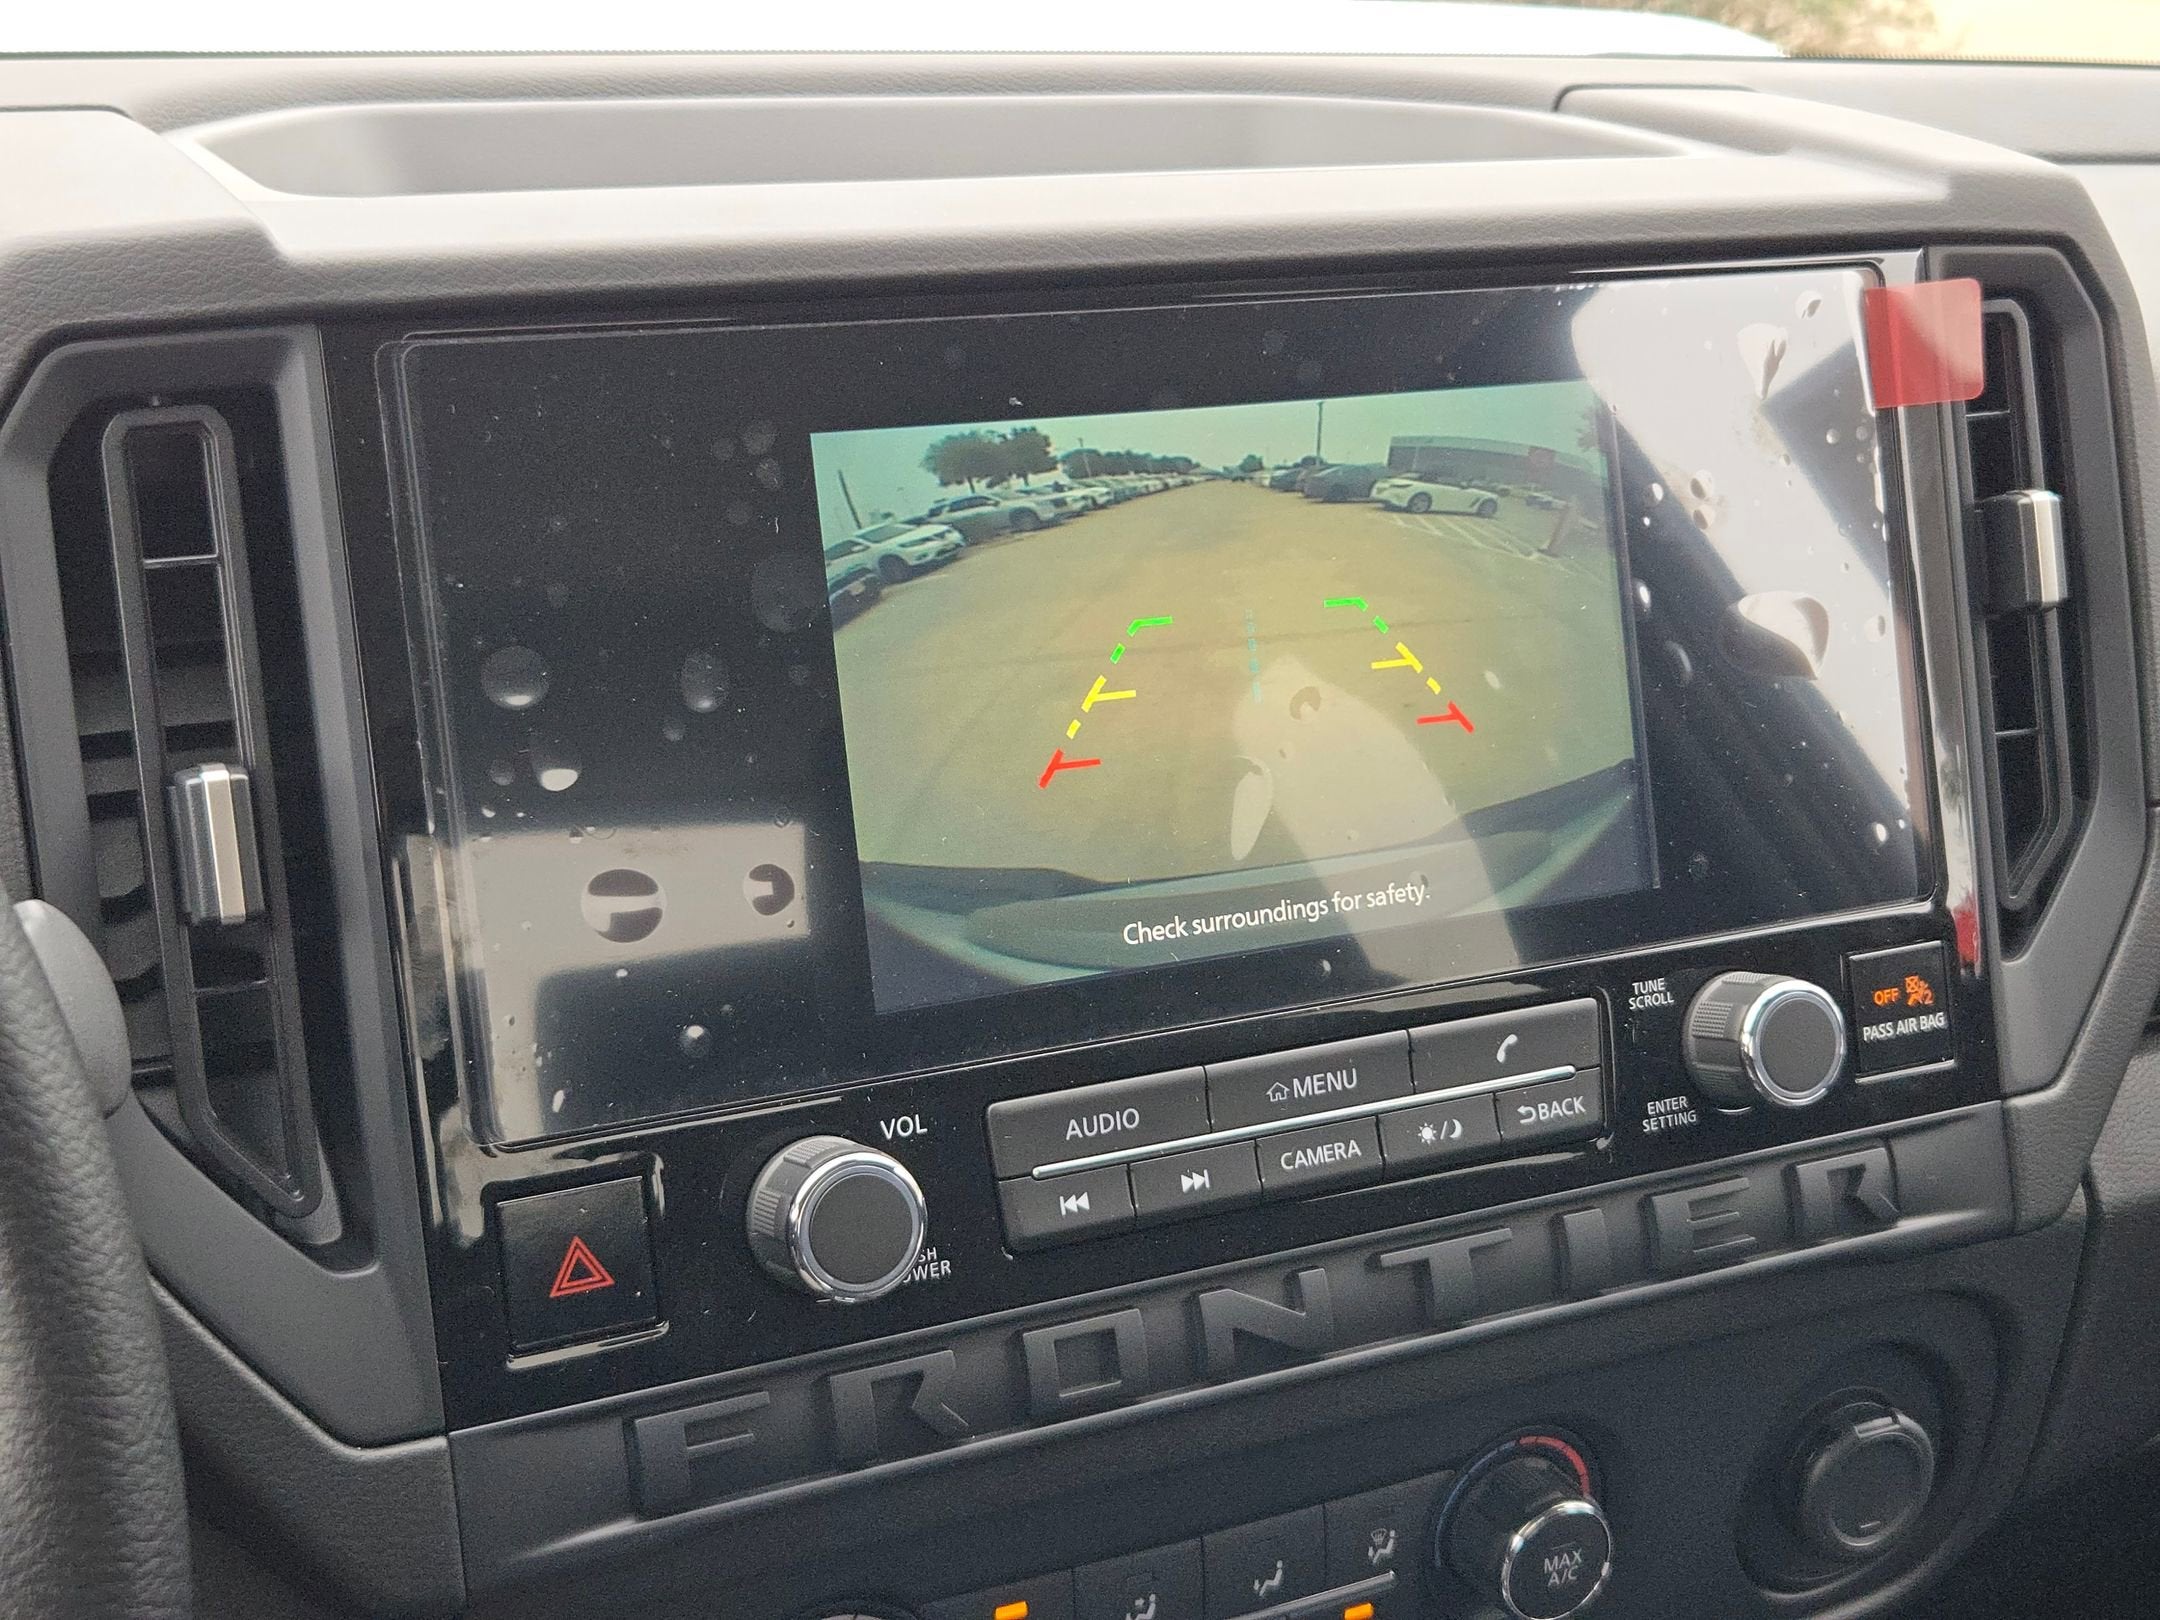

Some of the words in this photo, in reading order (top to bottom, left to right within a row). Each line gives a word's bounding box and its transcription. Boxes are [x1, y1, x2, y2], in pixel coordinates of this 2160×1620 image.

[1122, 916, 1189, 946] Check
[1192, 897, 1329, 936] surroundings
[1331, 890, 1363, 913] for
[1366, 881, 1432, 908] safety.
[1632, 977, 1666, 997] TUNE
[1874, 987, 1899, 1006] OFF
[1628, 991, 1674, 1010] SCROLL
[1863, 1021, 1894, 1041] PASS
[1896, 1017, 1918, 1035] AIR
[1919, 1011, 1945, 1031] BAG
[1293, 1067, 1358, 1099] MENU
[1538, 1095, 1586, 1122] BACK
[1647, 1095, 1687, 1116] ENTER
[879, 1114, 928, 1140] VOL
[1065, 1108, 1141, 1141] AUDIO
[1642, 1109, 1697, 1133] SETTING
[1280, 1139, 1362, 1172] CAMERA
[903, 1259, 951, 1283] WER
[635, 1147, 1900, 1505] FRONTIER
[1543, 1547, 1582, 1574] MAX
[1547, 1565, 1578, 1587] A/C
